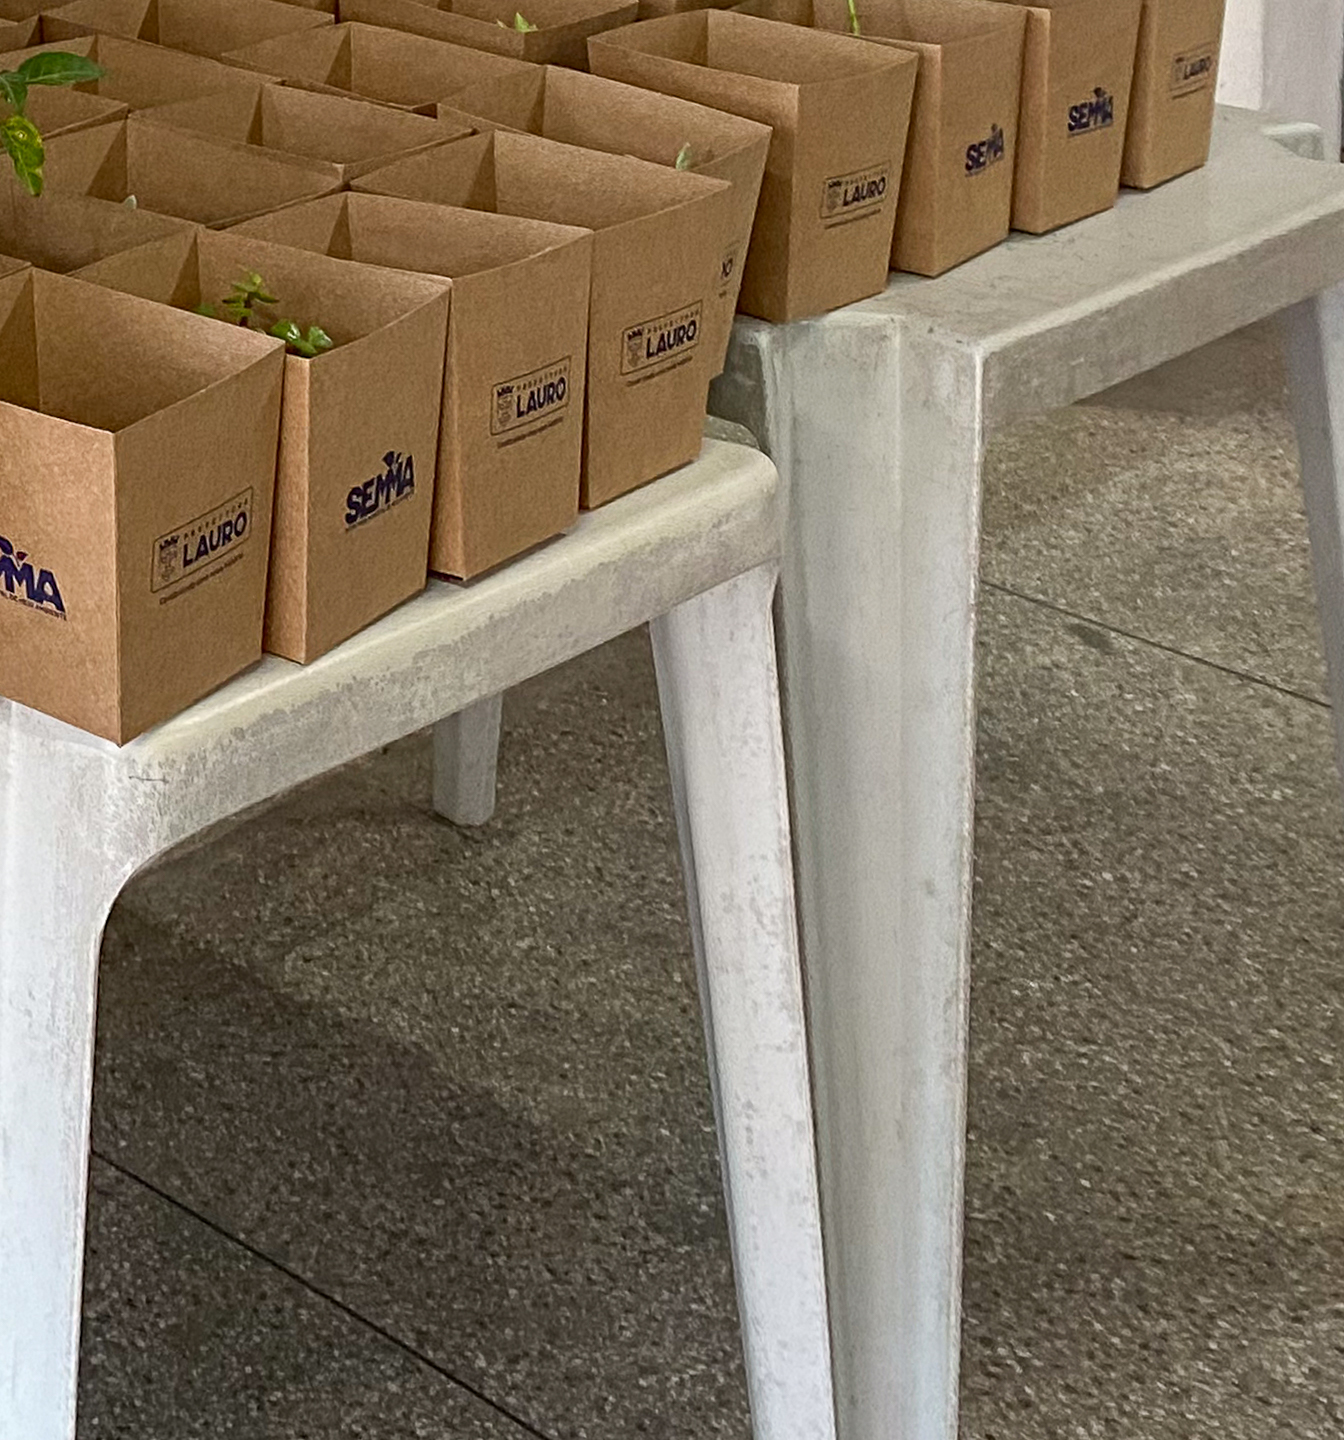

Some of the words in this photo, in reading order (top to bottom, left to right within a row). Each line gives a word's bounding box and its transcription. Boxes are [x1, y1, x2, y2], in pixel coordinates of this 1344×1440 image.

[842, 176, 887, 207] LAURO
[645, 319, 697, 360] LAURO
[516, 376, 566, 419] LAURO
[345, 454, 415, 524] SEMMA
[183, 511, 248, 569] LAURO
